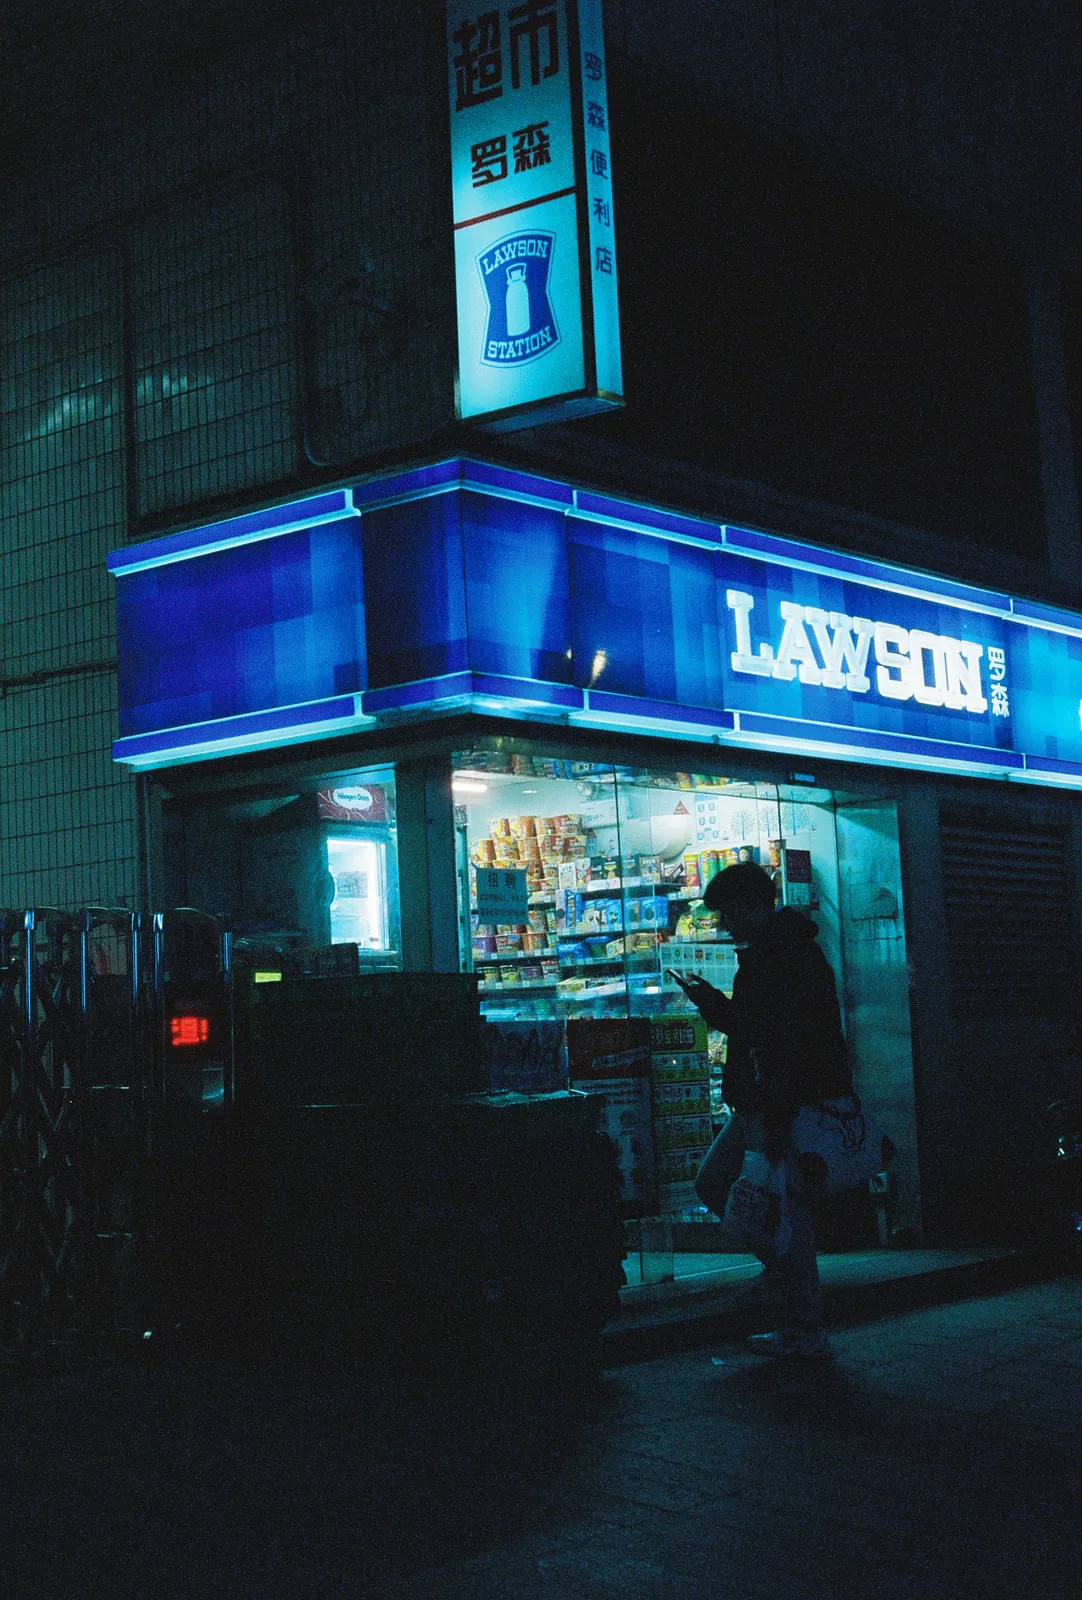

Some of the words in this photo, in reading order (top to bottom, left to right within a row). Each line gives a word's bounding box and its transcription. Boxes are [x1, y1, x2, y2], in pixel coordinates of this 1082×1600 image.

[453, 0, 560, 112] 超市
[471, 120, 551, 188] 罗森
[584, 51, 612, 275] 罗森便利店
[483, 239, 550, 275] LAWSON
[487, 326, 553, 360] STATION
[726, 589, 988, 713] LAWSON
[987, 646, 1010, 717] 罗森
